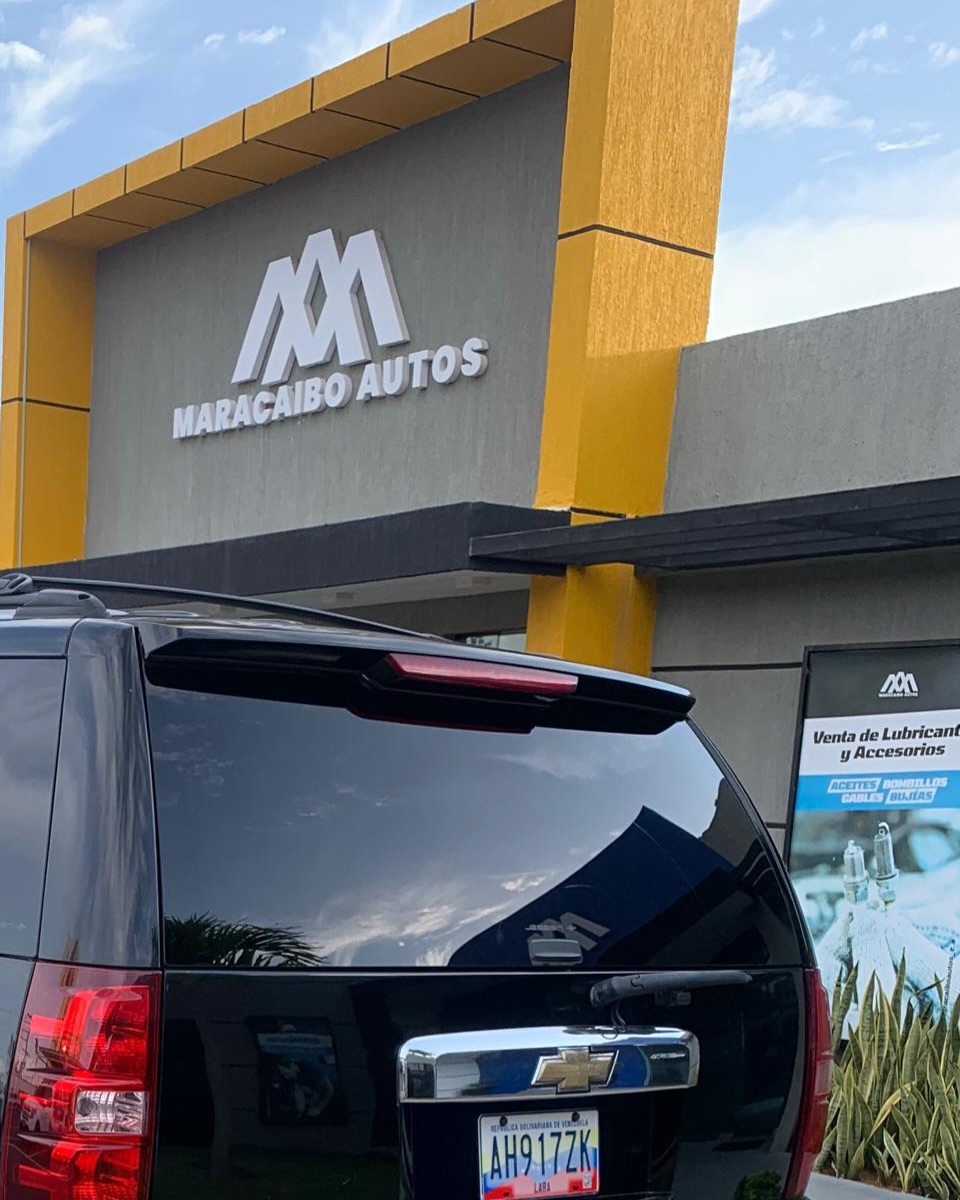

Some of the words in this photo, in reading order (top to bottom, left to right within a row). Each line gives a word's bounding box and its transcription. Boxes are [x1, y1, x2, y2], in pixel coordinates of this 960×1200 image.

[172, 372, 352, 440] MARACAIBO
[356, 337, 489, 402] AUTOS
[813, 730, 856, 744] Venta
[859, 728, 879, 742] de
[840, 749, 851, 763] y
[853, 743, 946, 759] Accesorios
[830, 779, 877, 791] ACEITES
[882, 777, 948, 790] BOMBILLOS
[841, 792, 884, 804] CABLES
[490, 1129, 591, 1180] AH917ZK
[533, 1182, 551, 1194] LARA
